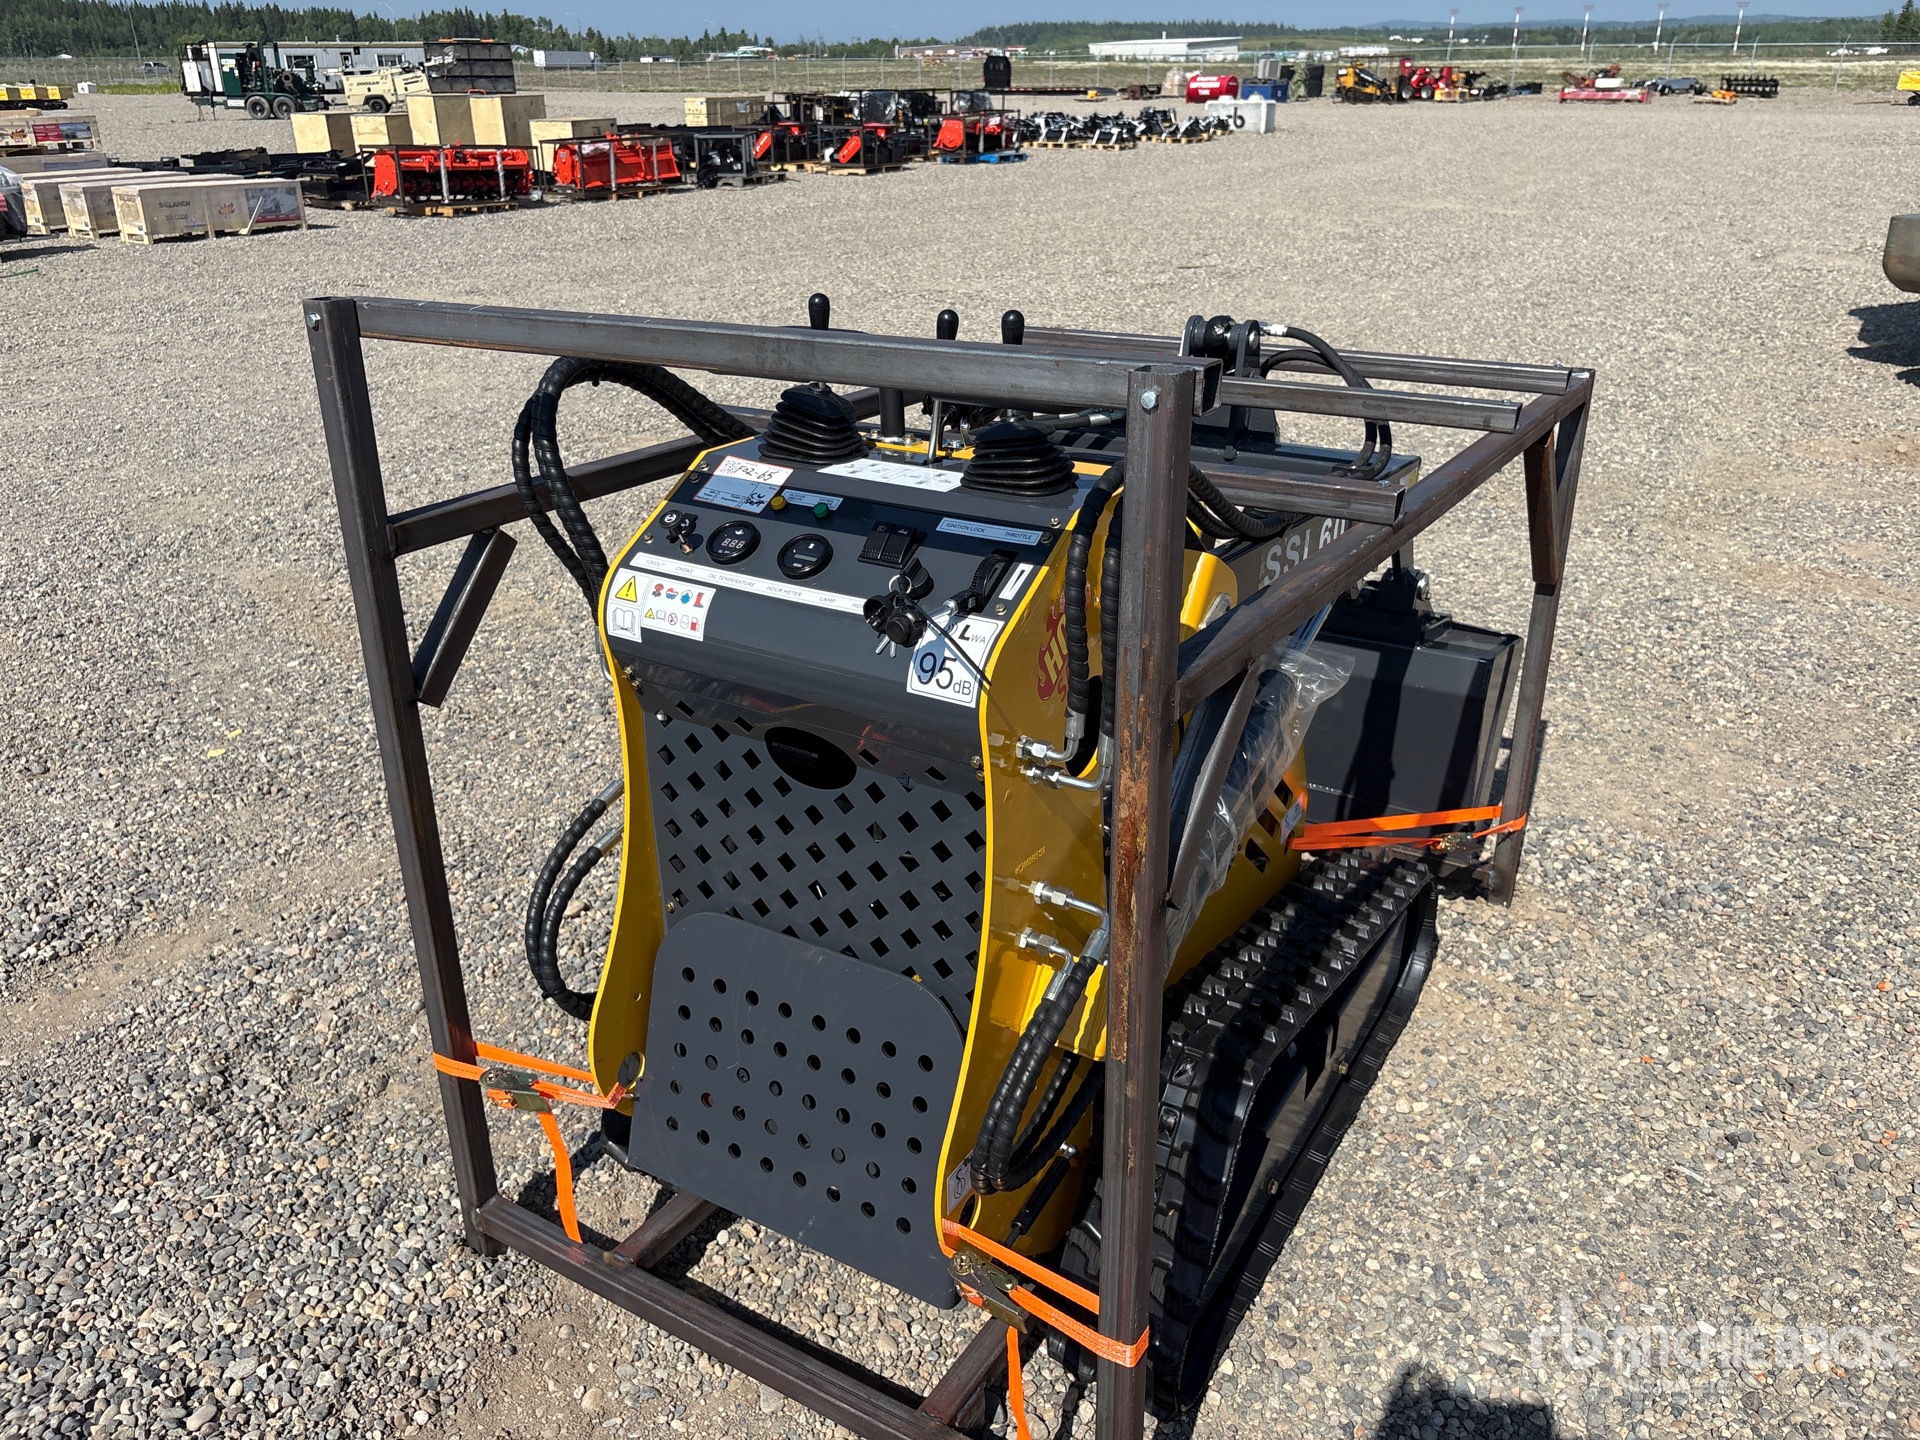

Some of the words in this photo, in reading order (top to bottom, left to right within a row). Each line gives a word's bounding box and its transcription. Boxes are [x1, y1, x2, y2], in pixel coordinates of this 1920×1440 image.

[946, 522, 971, 532] IGNITION
[971, 526, 986, 534] LOCK
[1004, 531, 1033, 540] THROTTLE
[675, 566, 695, 574] CHOKE
[708, 573, 719, 581] OIL
[719, 575, 756, 587] TEMPERATURE
[766, 585, 783, 594] HOUR
[783, 588, 803, 597] METER
[819, 596, 836, 604] LAMP
